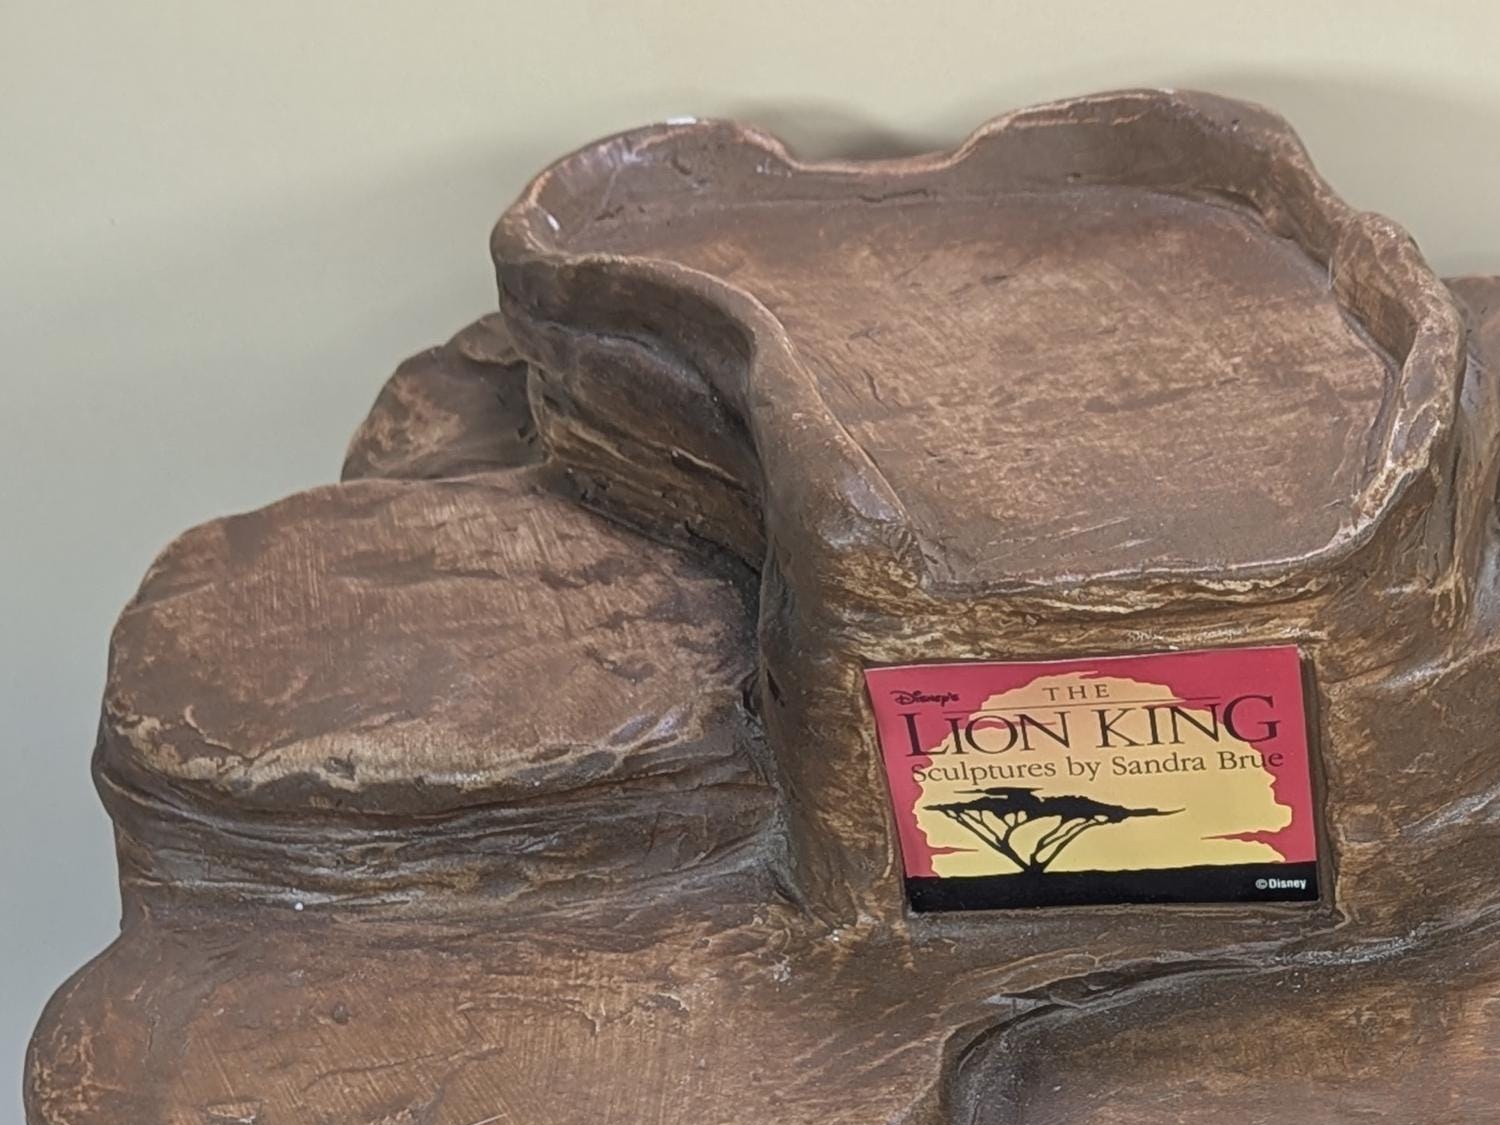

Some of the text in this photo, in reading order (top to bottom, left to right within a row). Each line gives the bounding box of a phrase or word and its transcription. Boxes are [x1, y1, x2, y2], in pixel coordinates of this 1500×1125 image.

[1042, 684, 1110, 701] THE
[897, 694, 1281, 757] LION KING
[911, 750, 1284, 785] Sculptures by Sandra Brue
